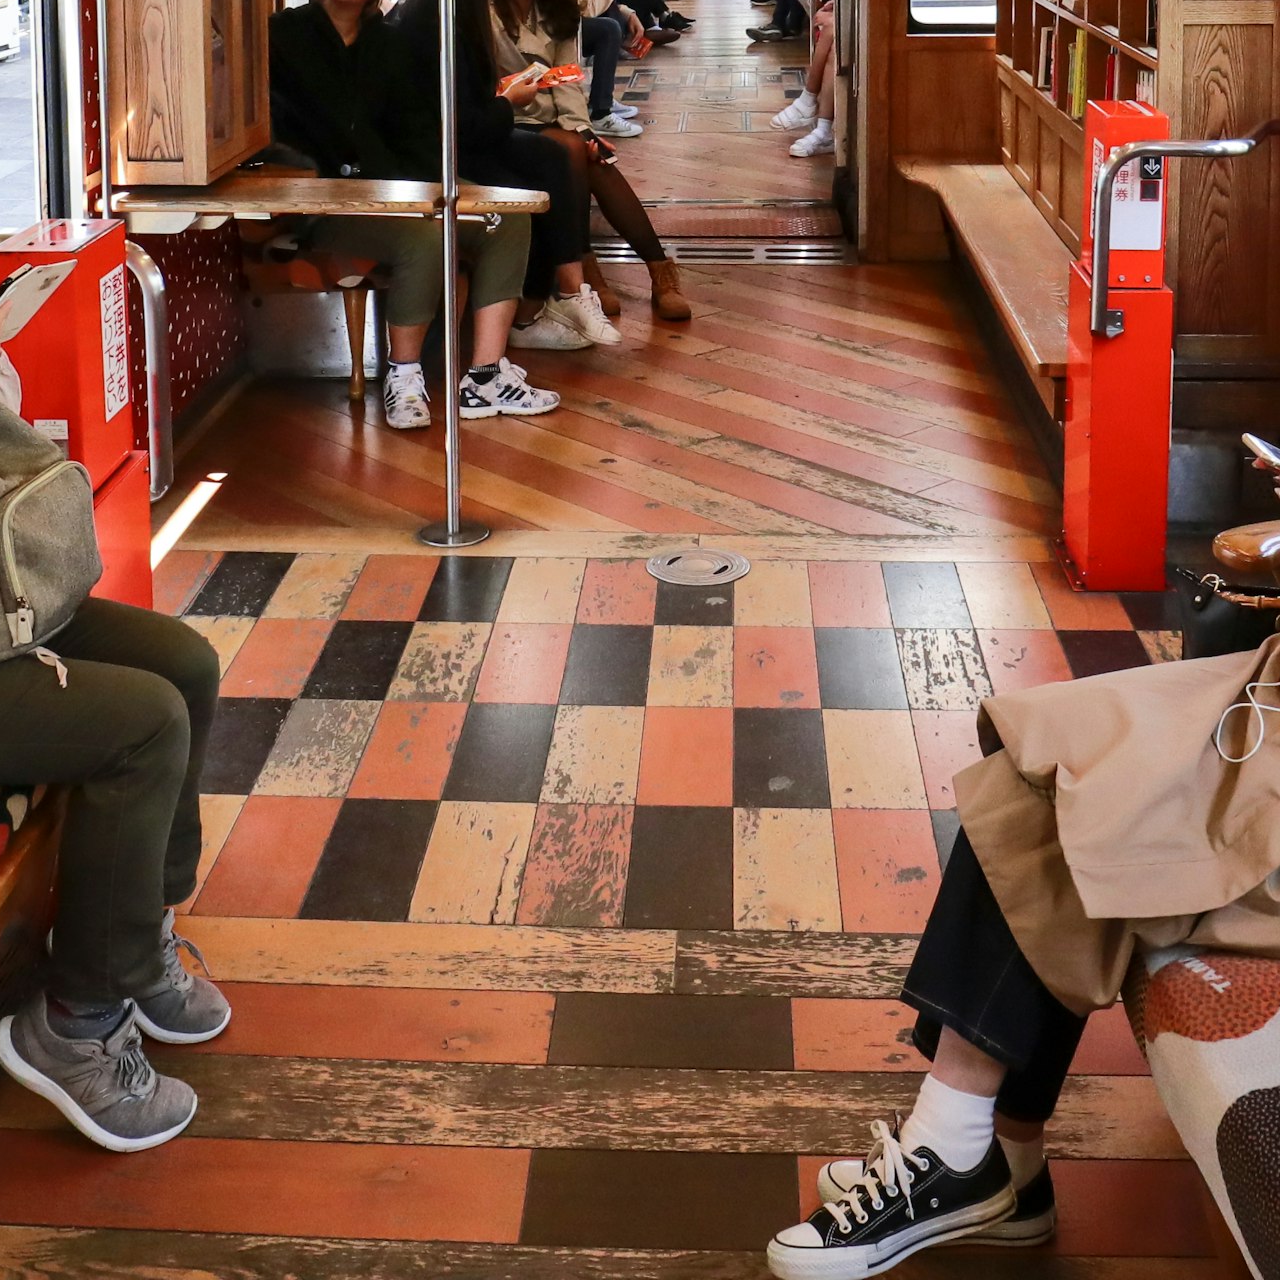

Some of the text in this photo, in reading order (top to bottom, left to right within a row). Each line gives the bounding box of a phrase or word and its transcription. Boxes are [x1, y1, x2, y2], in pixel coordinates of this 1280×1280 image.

[101, 277, 117, 413] おとり下さい
